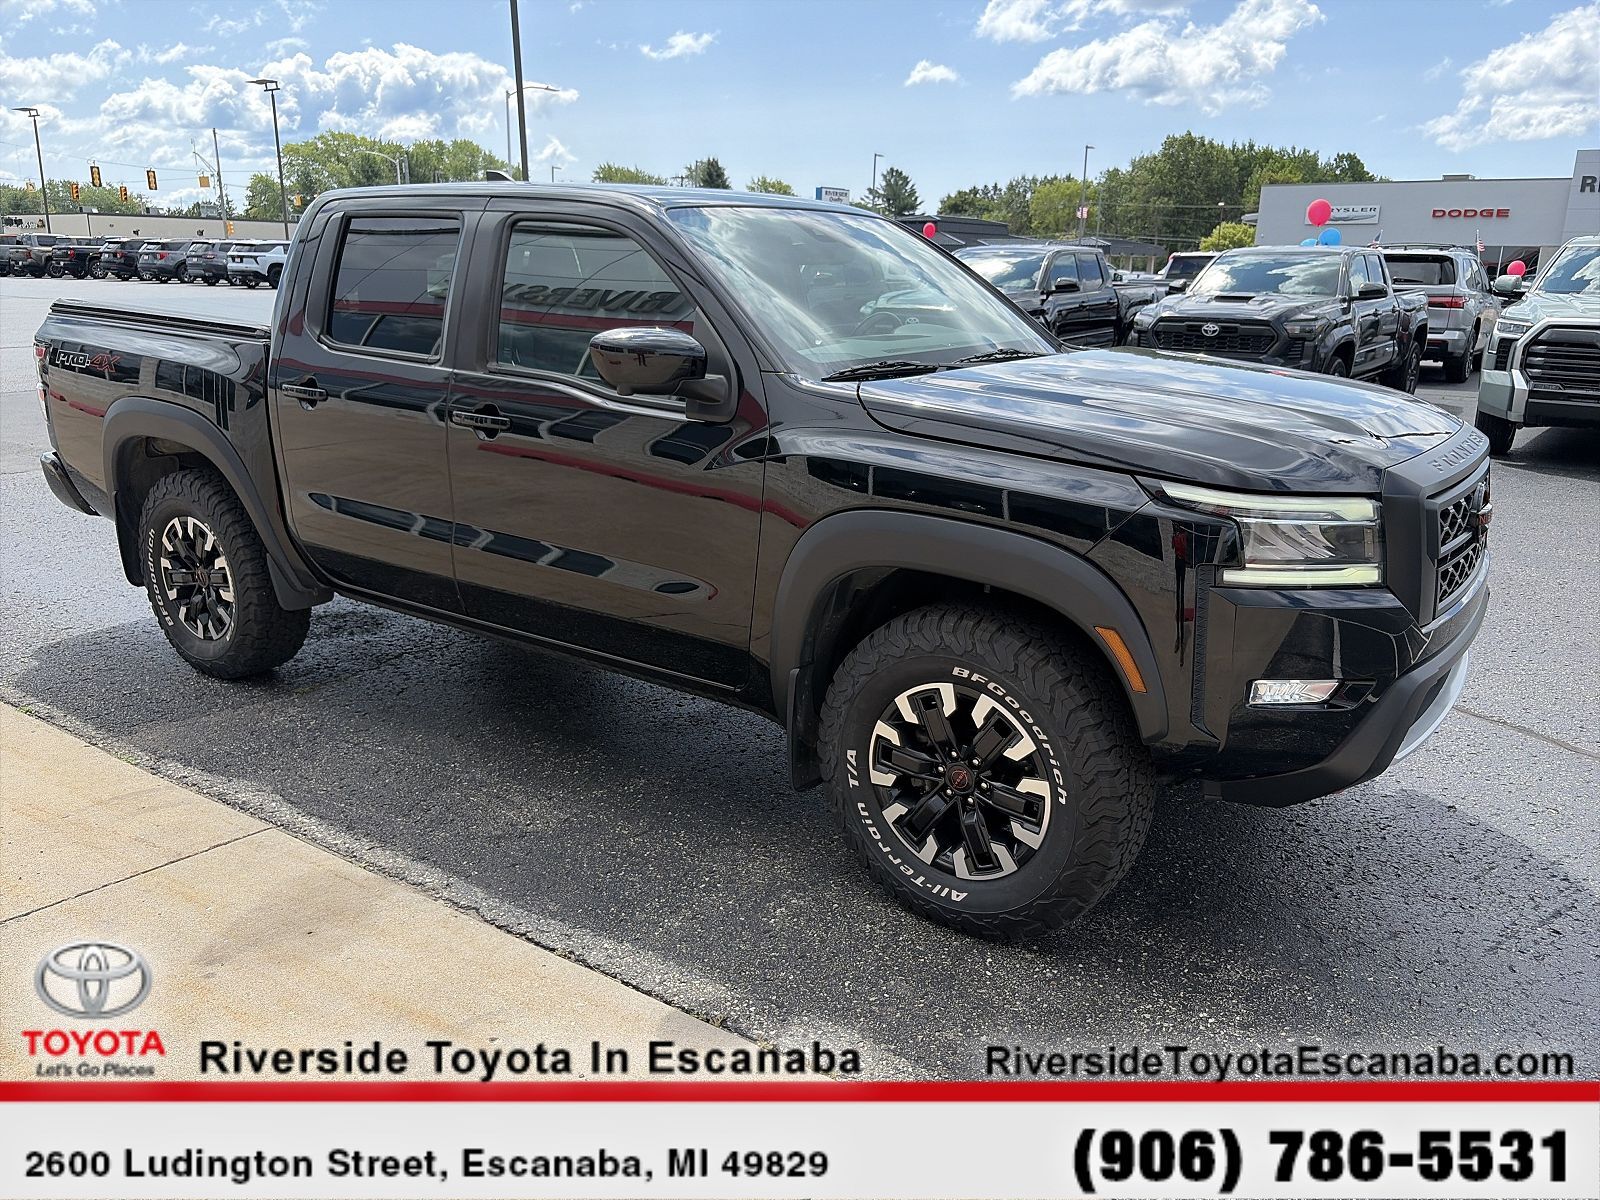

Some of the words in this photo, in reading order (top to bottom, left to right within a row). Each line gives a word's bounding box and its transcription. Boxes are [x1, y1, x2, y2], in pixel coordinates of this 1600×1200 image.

[1579, 175, 1600, 193] R
[1432, 208, 1510, 218] DODGE
[55, 349, 121, 373] PRO-4X
[147, 528, 175, 626] BFGoodrich
[952, 666, 1068, 805] BFGoodrich
[846, 749, 860, 788] T/A
[857, 802, 968, 902] All-Terrain
